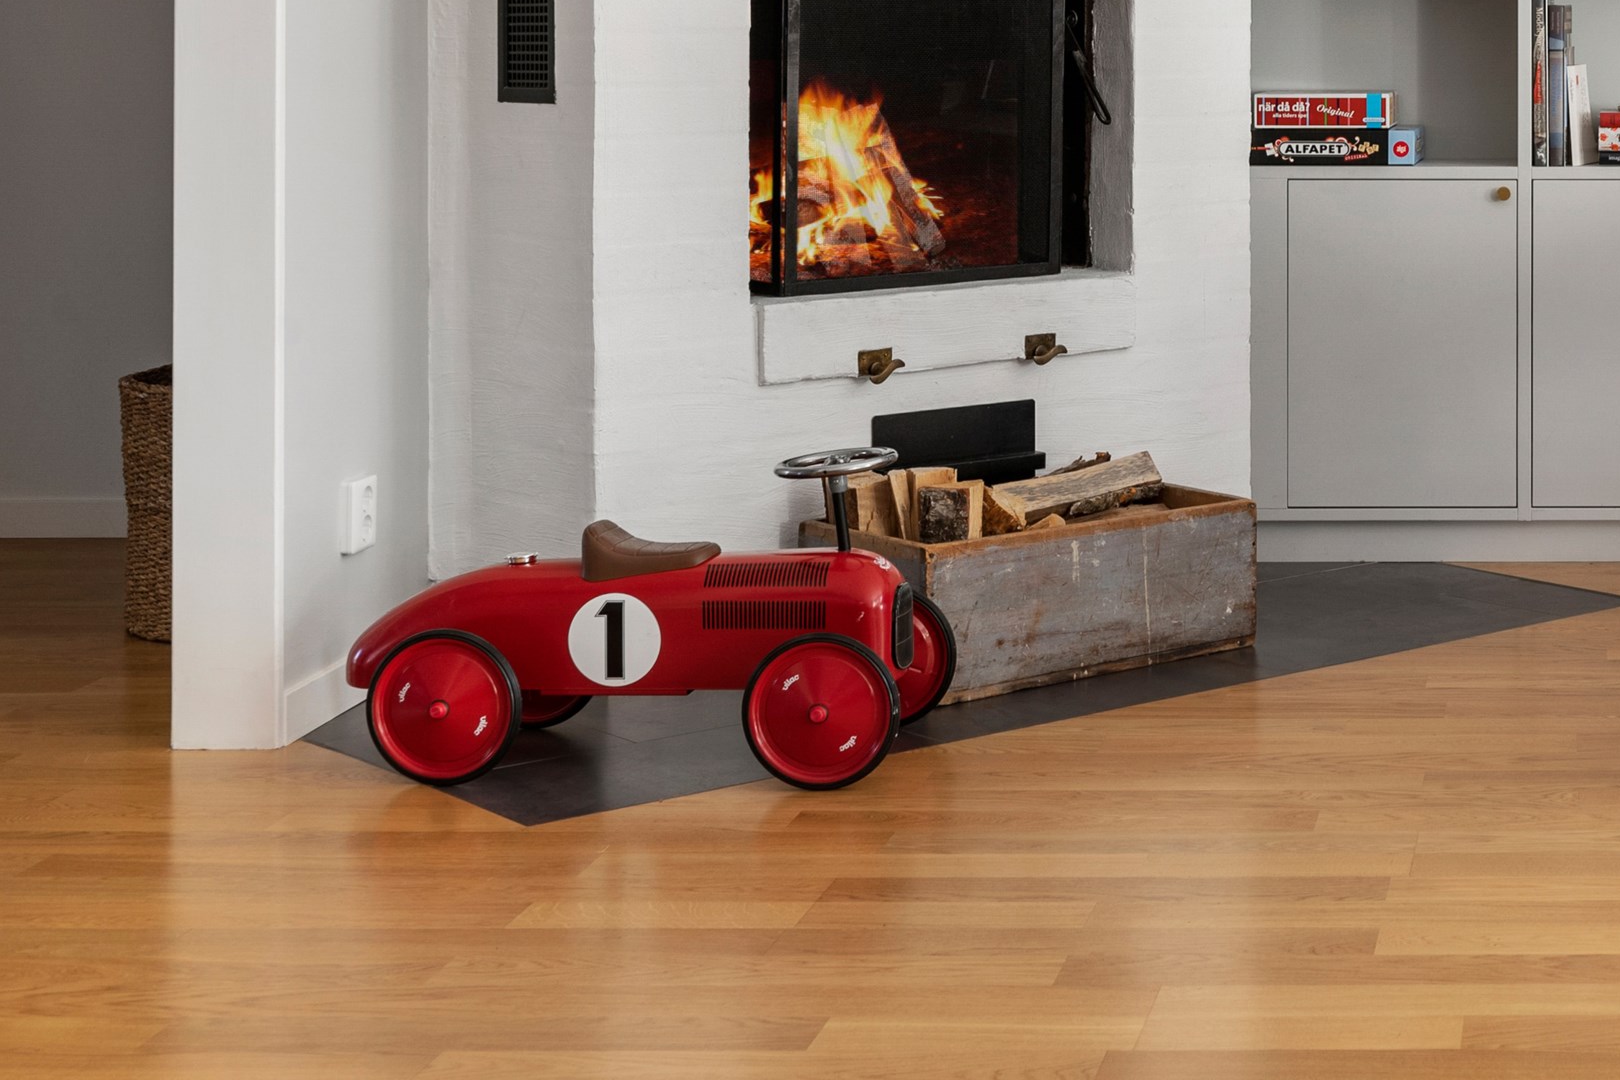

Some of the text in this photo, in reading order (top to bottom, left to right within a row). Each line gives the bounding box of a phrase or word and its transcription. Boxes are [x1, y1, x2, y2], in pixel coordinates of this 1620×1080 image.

[1535, 7, 1545, 46] Modelejon
[1258, 101, 1310, 112] när då då?
[1316, 104, 1356, 118] Original
[1285, 144, 1343, 154] ALFAPET
[1345, 153, 1368, 161] ORIGINAL
[595, 600, 626, 680] 1
[782, 674, 800, 691] vilac
[398, 682, 411, 703] vilac
[474, 715, 488, 736] vilac
[839, 735, 857, 752] vilac
